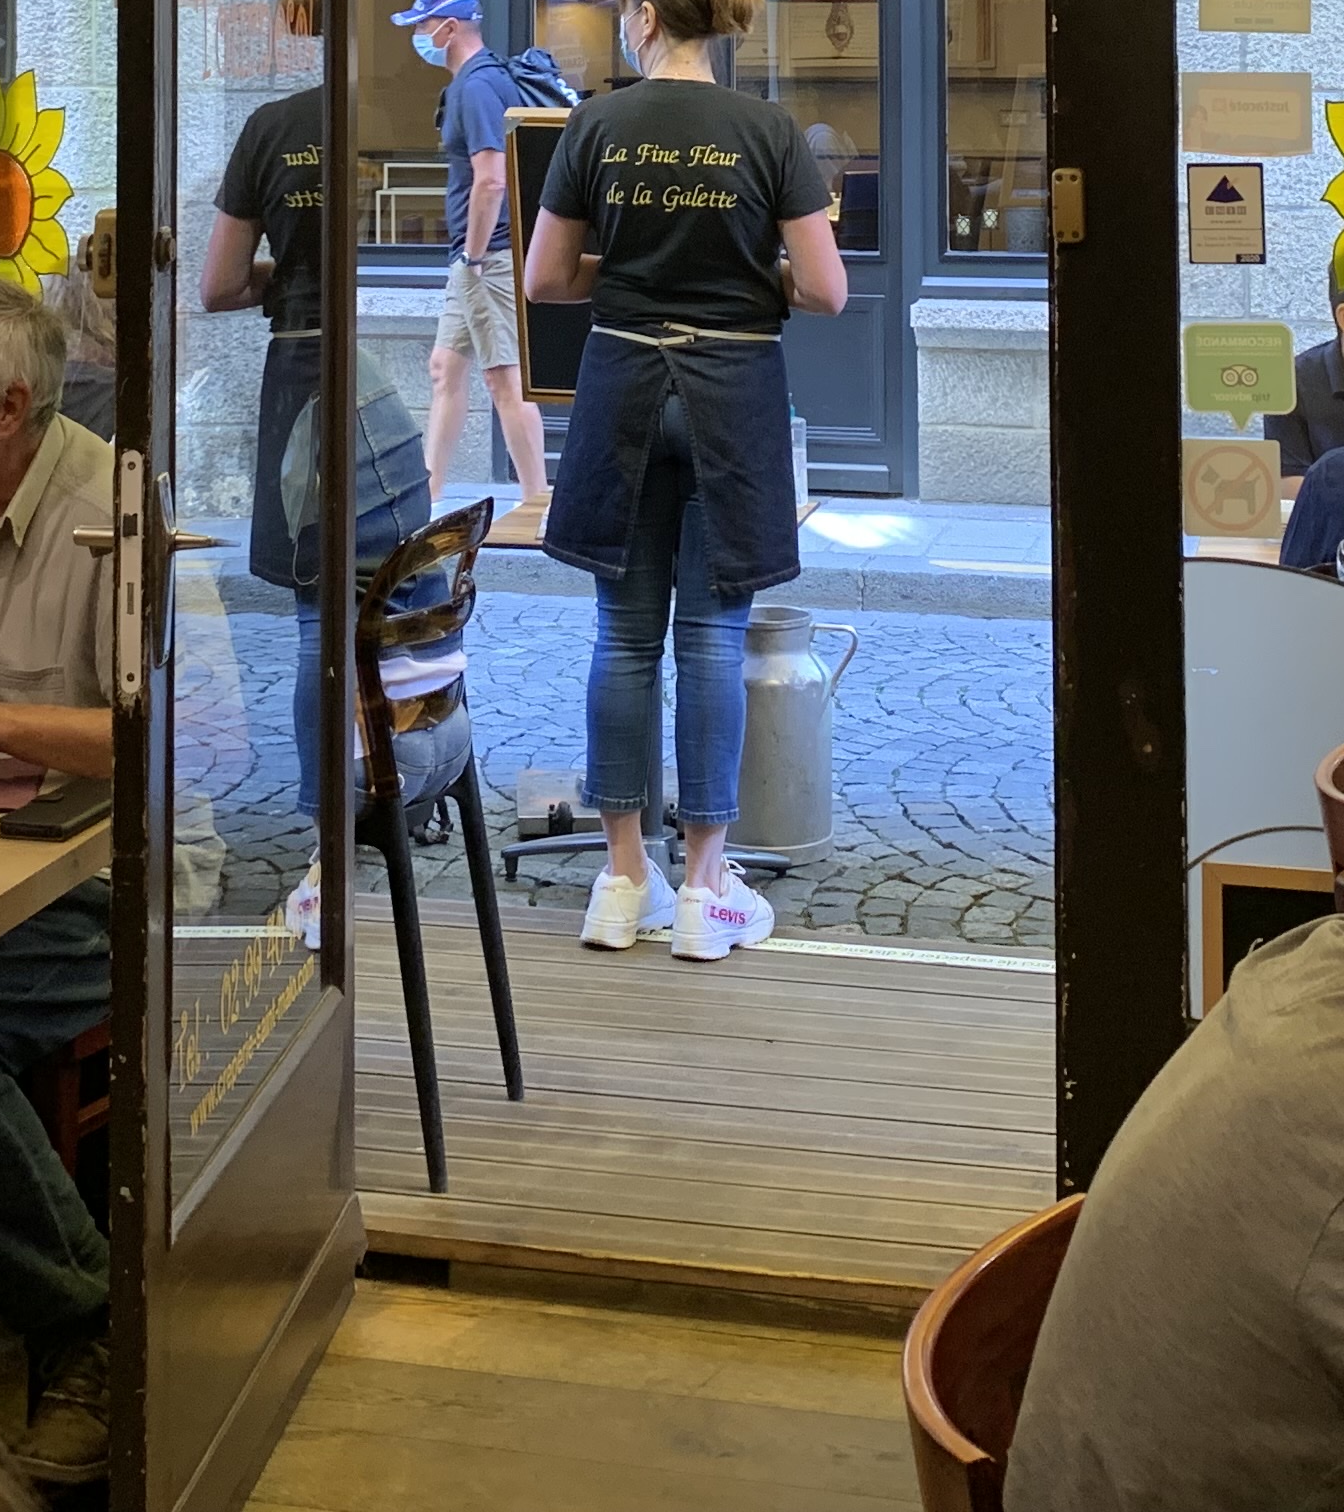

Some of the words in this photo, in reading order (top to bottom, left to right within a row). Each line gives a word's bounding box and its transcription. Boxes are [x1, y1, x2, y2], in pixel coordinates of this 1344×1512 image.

[600, 143, 628, 163] La
[634, 143, 680, 166] Fine
[687, 143, 742, 167] Fleur
[606, 181, 625, 205] de
[632, 181, 653, 206] la
[662, 183, 738, 213] Galette
[1022, 960, 1054, 970] erci
